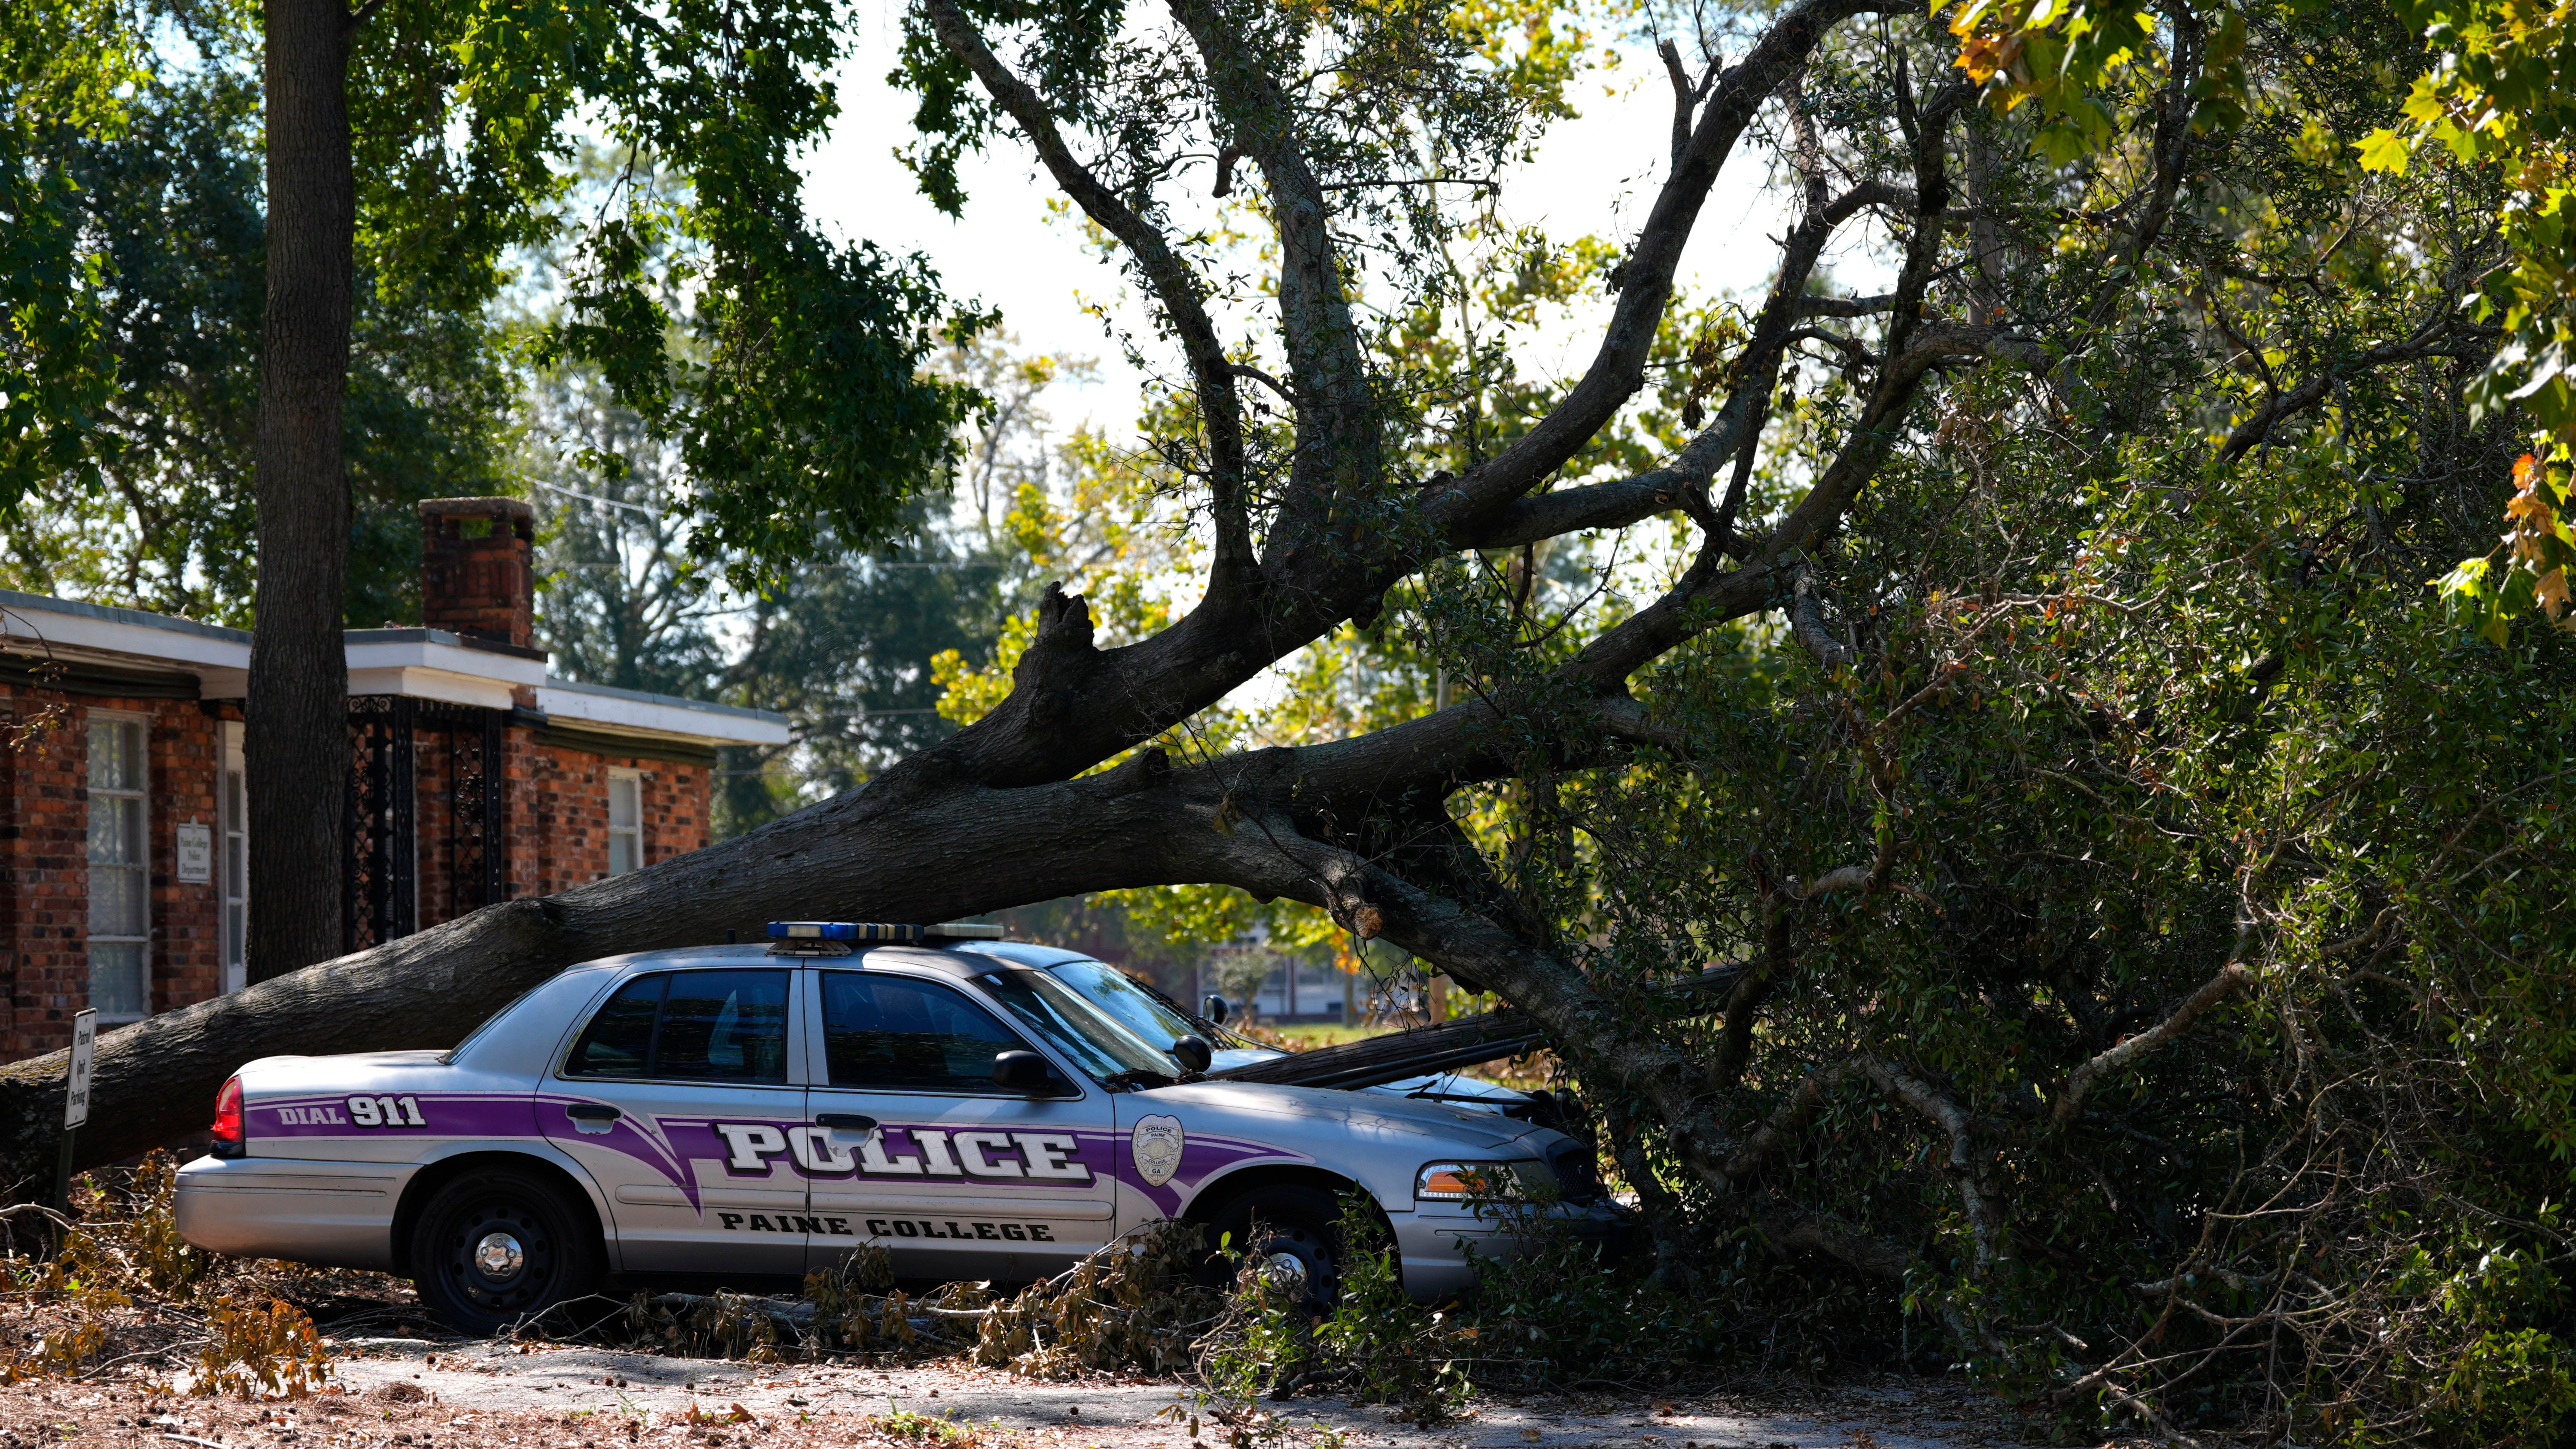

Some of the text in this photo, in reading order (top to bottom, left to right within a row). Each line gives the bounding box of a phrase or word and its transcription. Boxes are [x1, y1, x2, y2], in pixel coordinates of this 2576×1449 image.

[188, 851, 201, 861] Police
[182, 863, 206, 876] Department
[77, 1027, 91, 1046] Patrol
[77, 1059, 85, 1075] Unit
[70, 1088, 86, 1106] Parking
[277, 1096, 428, 1128] DIAL 911
[713, 1123, 1093, 1183] POLICE
[718, 1213, 1055, 1242] PAINE COLLEGE
